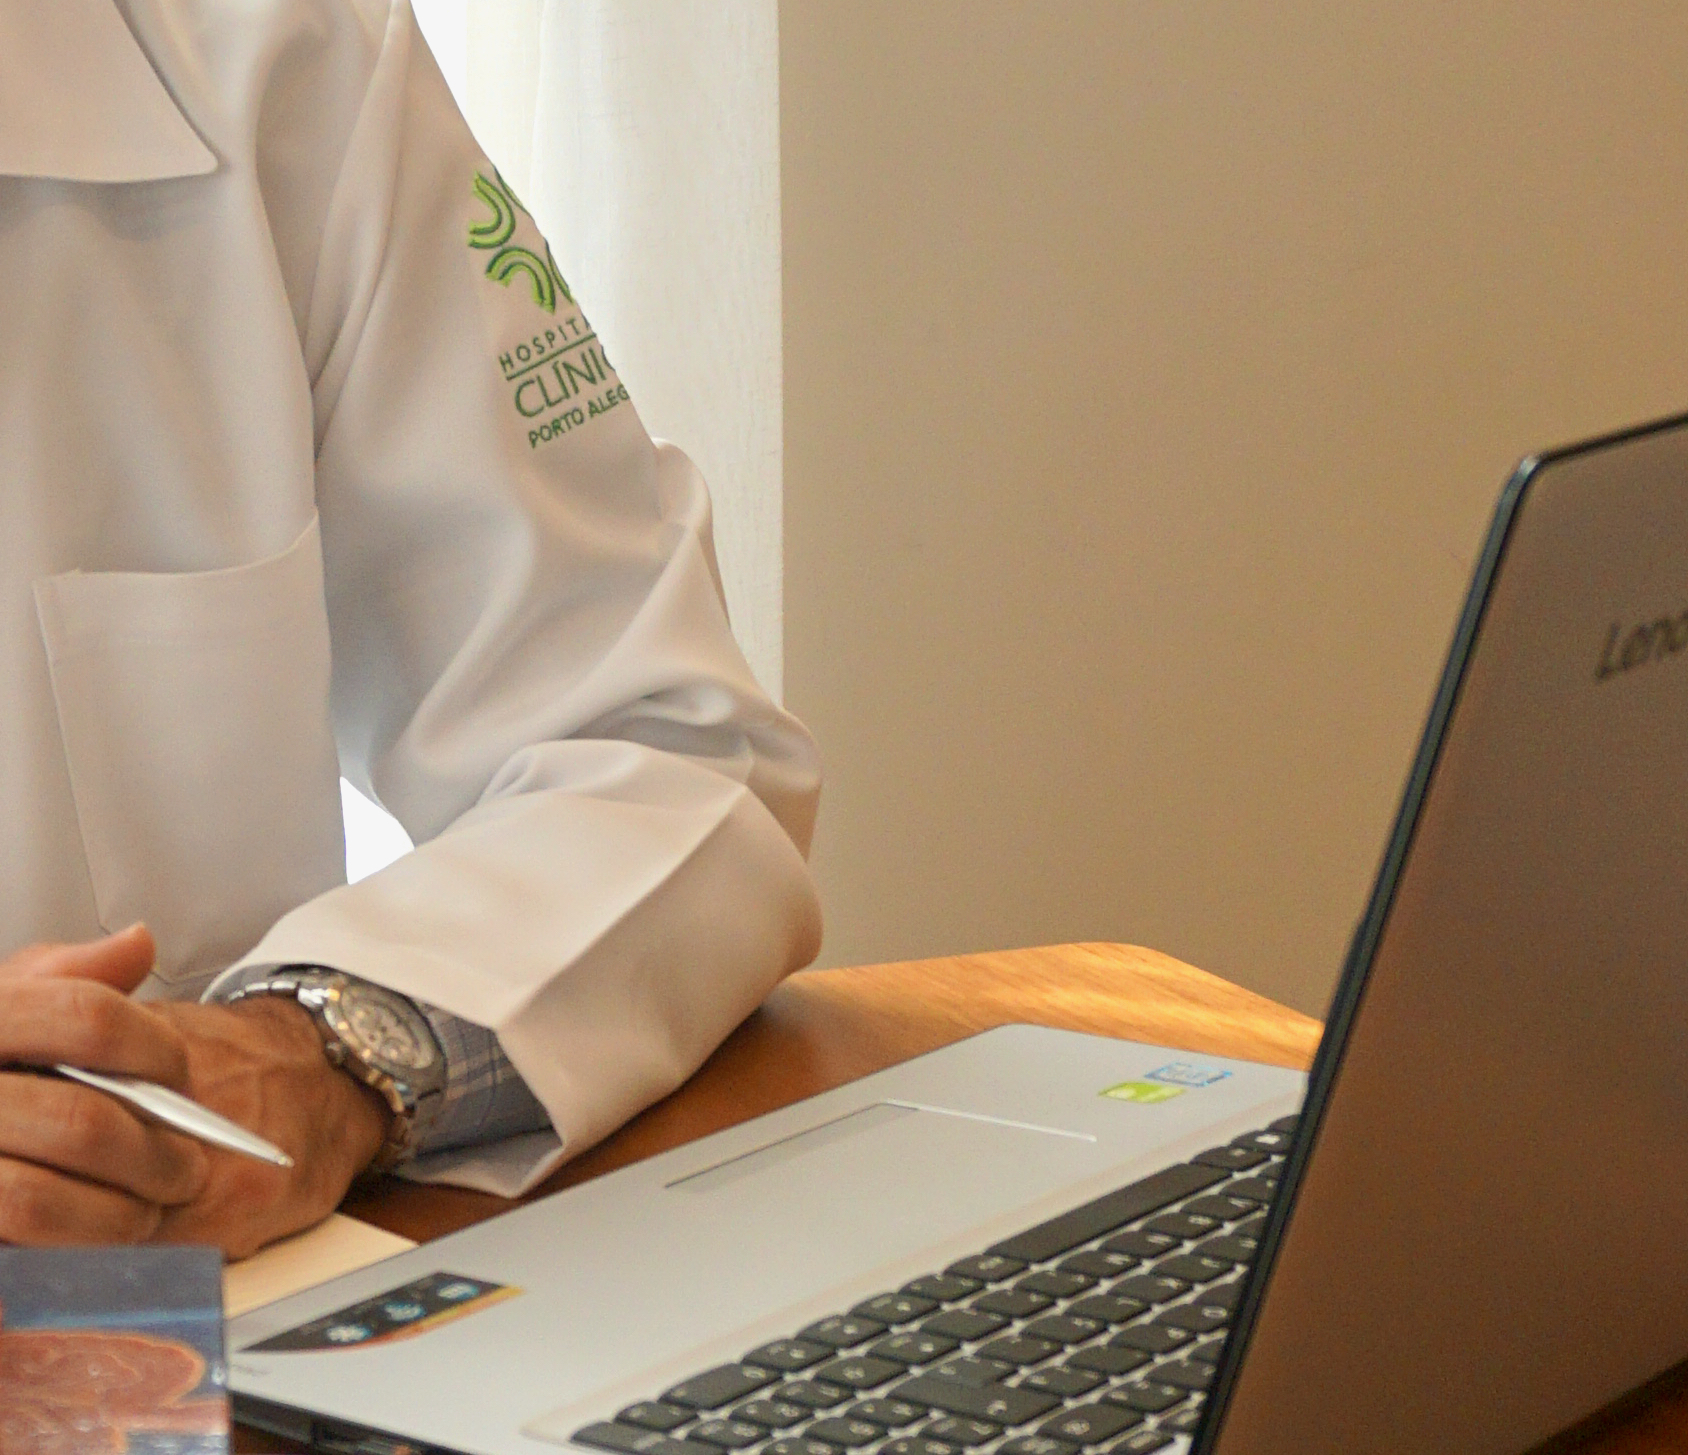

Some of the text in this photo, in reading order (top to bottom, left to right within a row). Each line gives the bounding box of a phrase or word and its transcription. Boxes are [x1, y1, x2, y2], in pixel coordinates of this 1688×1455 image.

[499, 316, 591, 373] HOSPIT
[528, 383, 631, 449] PORTO ALEG
